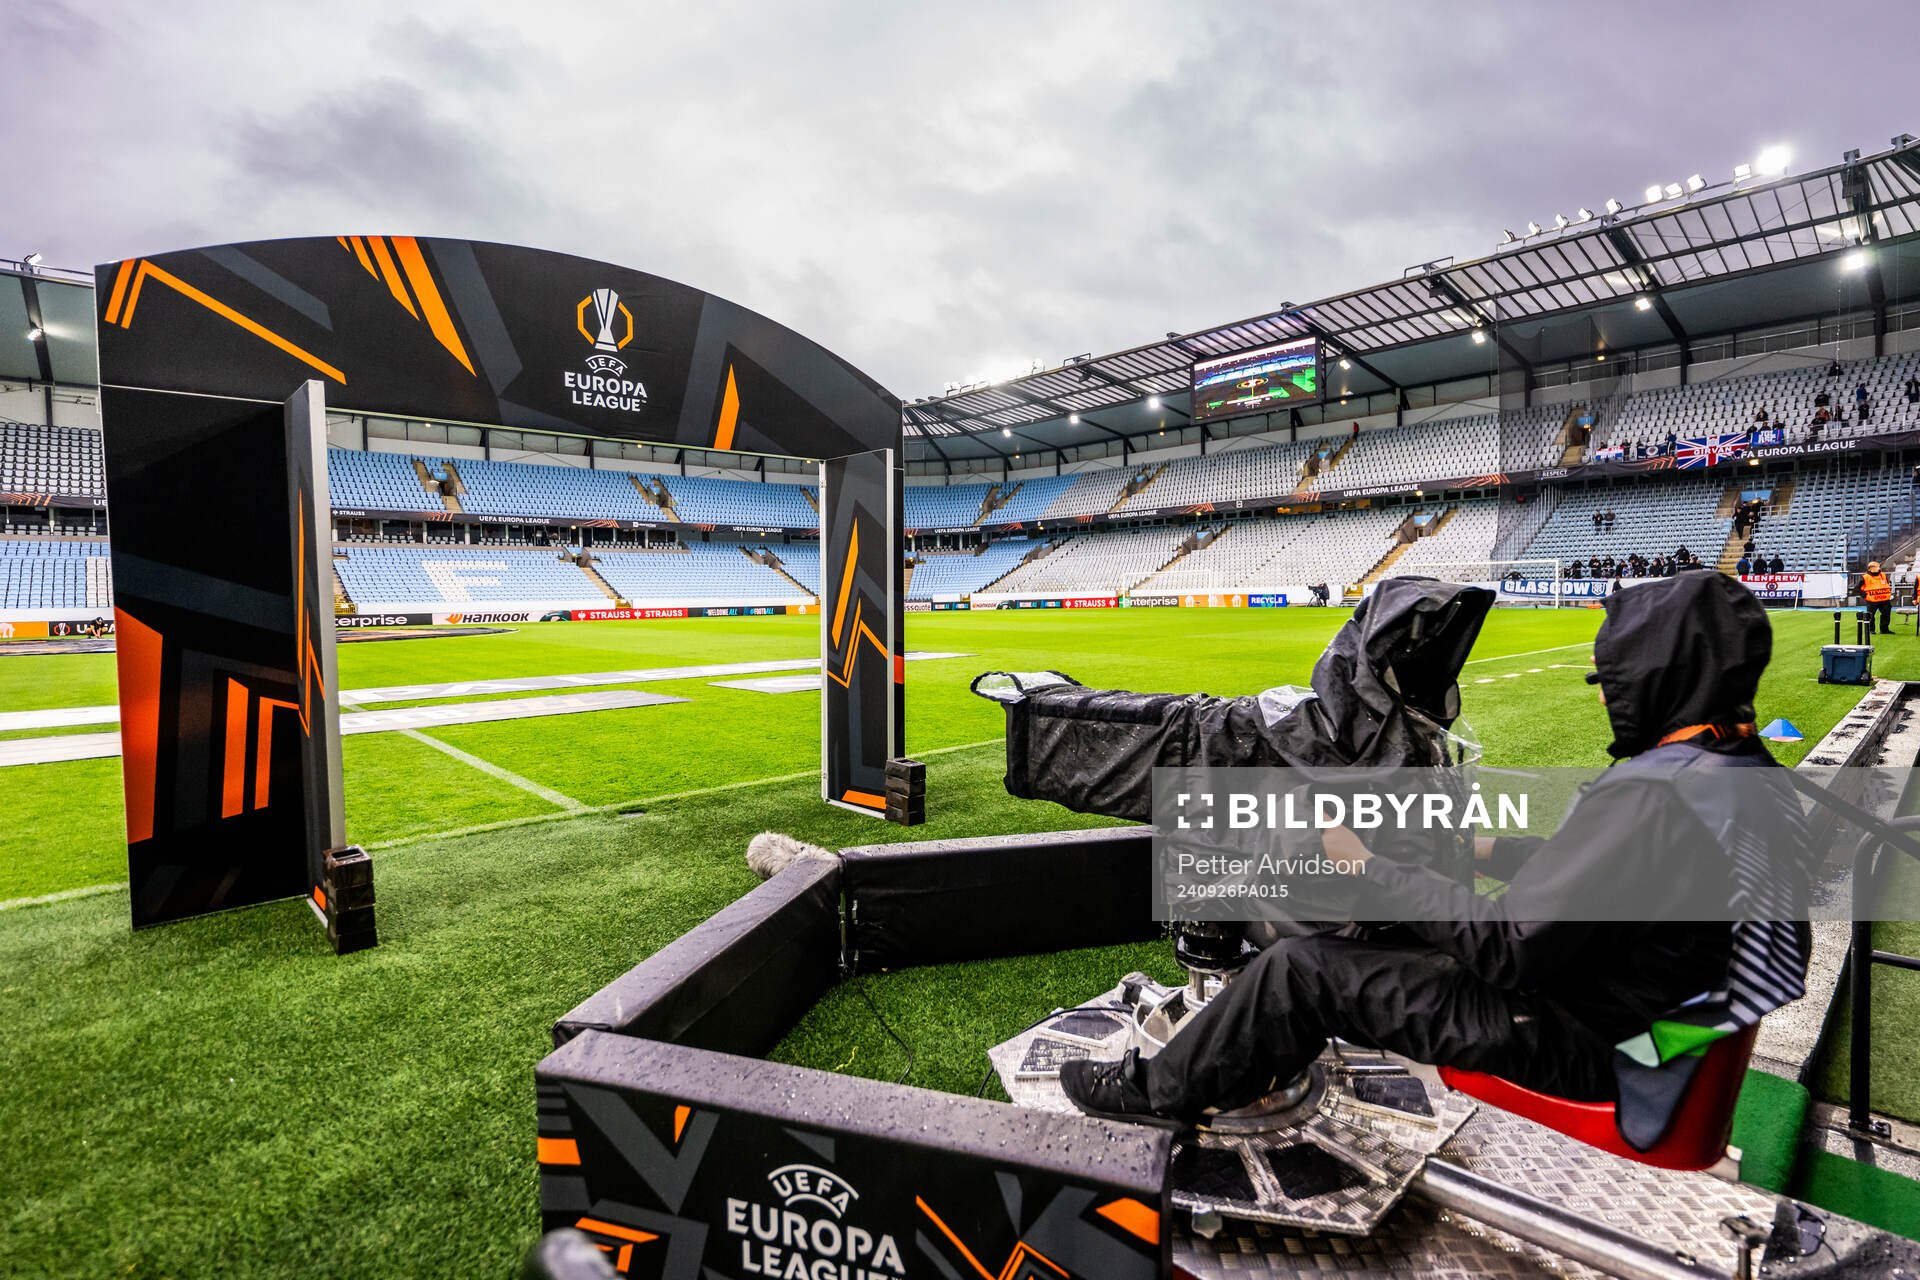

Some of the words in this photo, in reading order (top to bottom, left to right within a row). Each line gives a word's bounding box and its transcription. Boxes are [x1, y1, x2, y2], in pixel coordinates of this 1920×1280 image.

[587, 358, 623, 375] UEFA
[564, 371, 648, 398] EUROPA
[572, 390, 641, 412] LEAGUE
[1693, 446, 1733, 456] GIRVAN
[1757, 445, 1805, 457] EUROPA
[1807, 440, 1856, 453] LEAGUE
[1343, 489, 1361, 497] UEFA
[1362, 486, 1389, 496] EUROPA
[1390, 484, 1418, 493] LEAGUE
[1504, 580, 1591, 595] GLASGOW
[1074, 599, 1106, 608] STRAUSS
[335, 614, 408, 628] erprise
[589, 610, 631, 619] STRAUSS
[645, 609, 683, 618] STRAUSS
[772, 1171, 850, 1213] UEFA
[726, 1197, 906, 1275] EUROPA
[742, 1239, 889, 1280] LEAG
